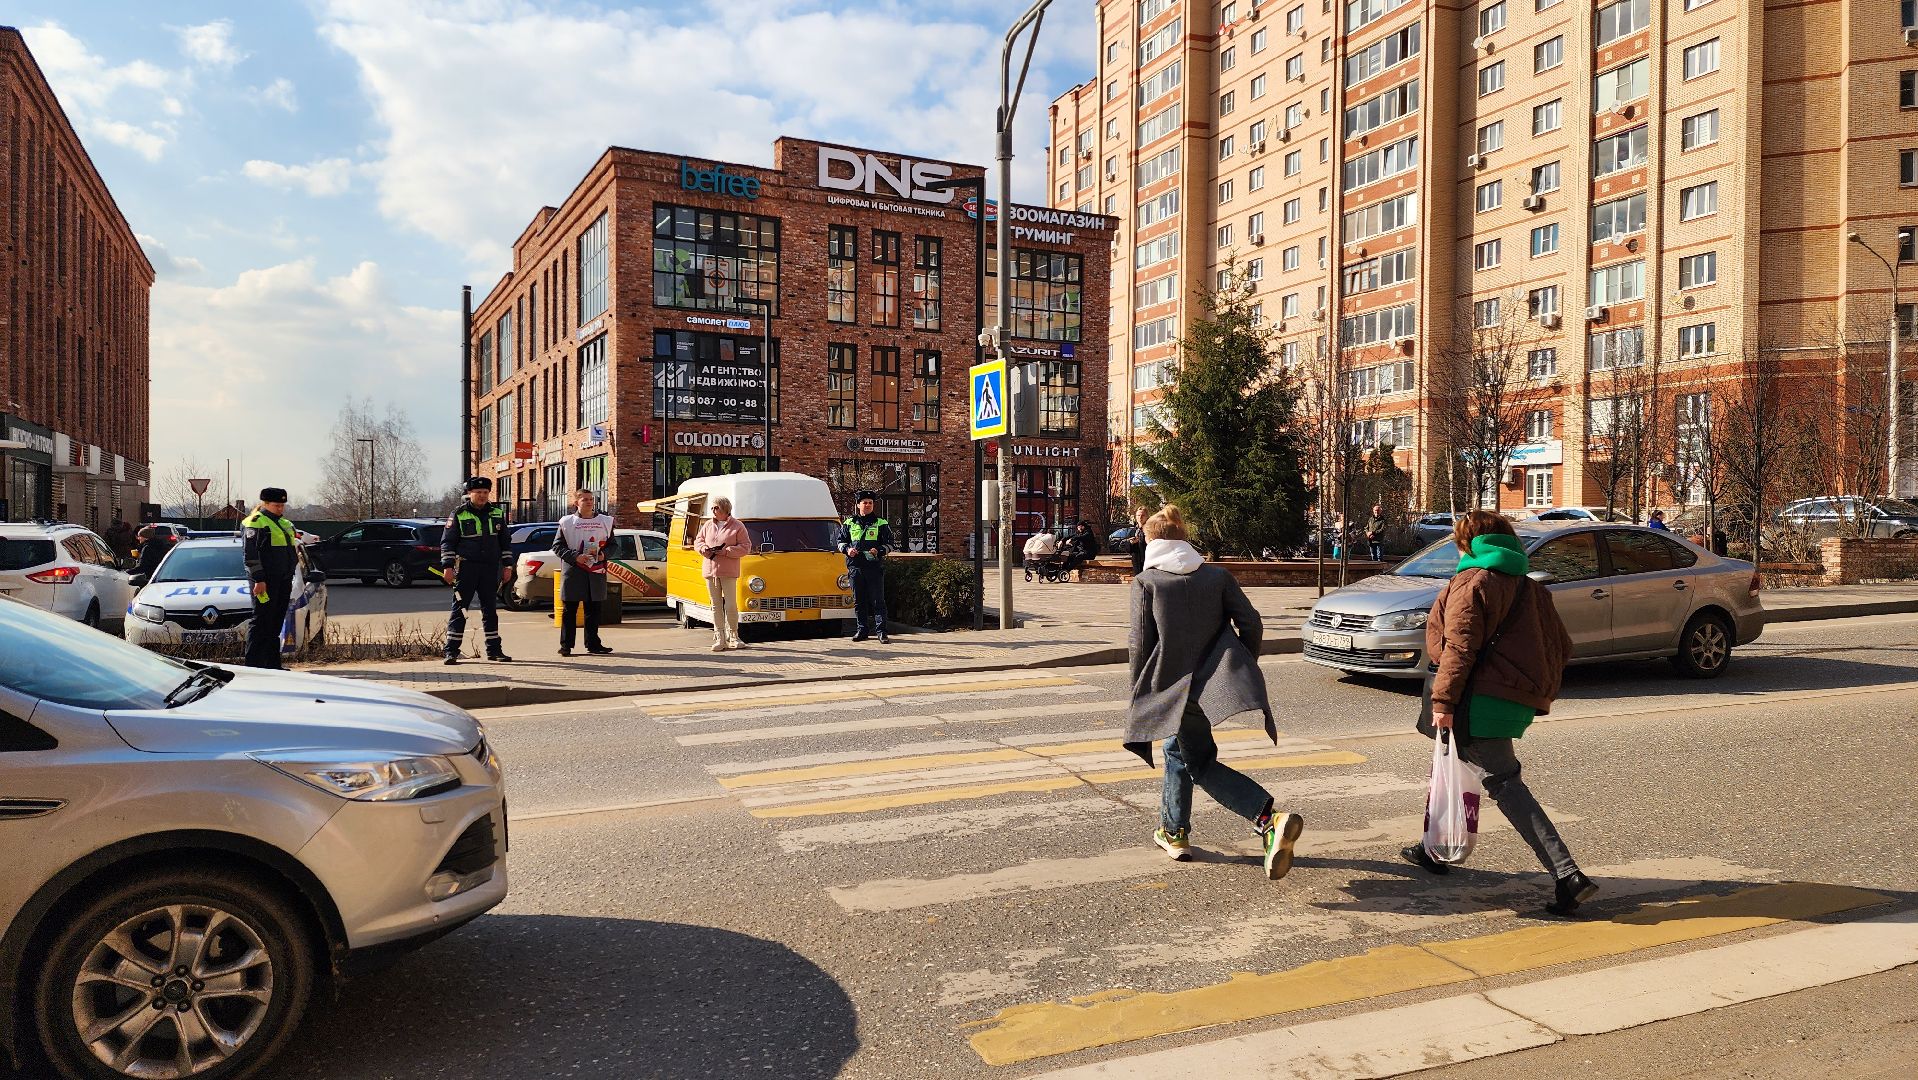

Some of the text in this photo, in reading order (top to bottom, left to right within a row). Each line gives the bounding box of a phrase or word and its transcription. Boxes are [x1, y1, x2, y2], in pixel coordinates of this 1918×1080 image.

[681, 160, 761, 199] befree
[818, 146, 955, 204] DNS
[827, 195, 946, 218] ЦИФРОВАЯ И БЫТОВАЯ ТЕХНИКА
[1010, 206, 1105, 230] ЗООМАГАЗИН
[1010, 226, 1075, 245] РУМИНГ
[686, 316, 727, 327] самолет
[688, 375, 768, 388] НЕДВИЖИМОСТ
[674, 432, 750, 448] COLODOFF
[864, 437, 925, 447] ИСТОРИЯ МЕСТА
[1013, 445, 1080, 457] UNLIGHT
[607, 561, 624, 576] АПА
